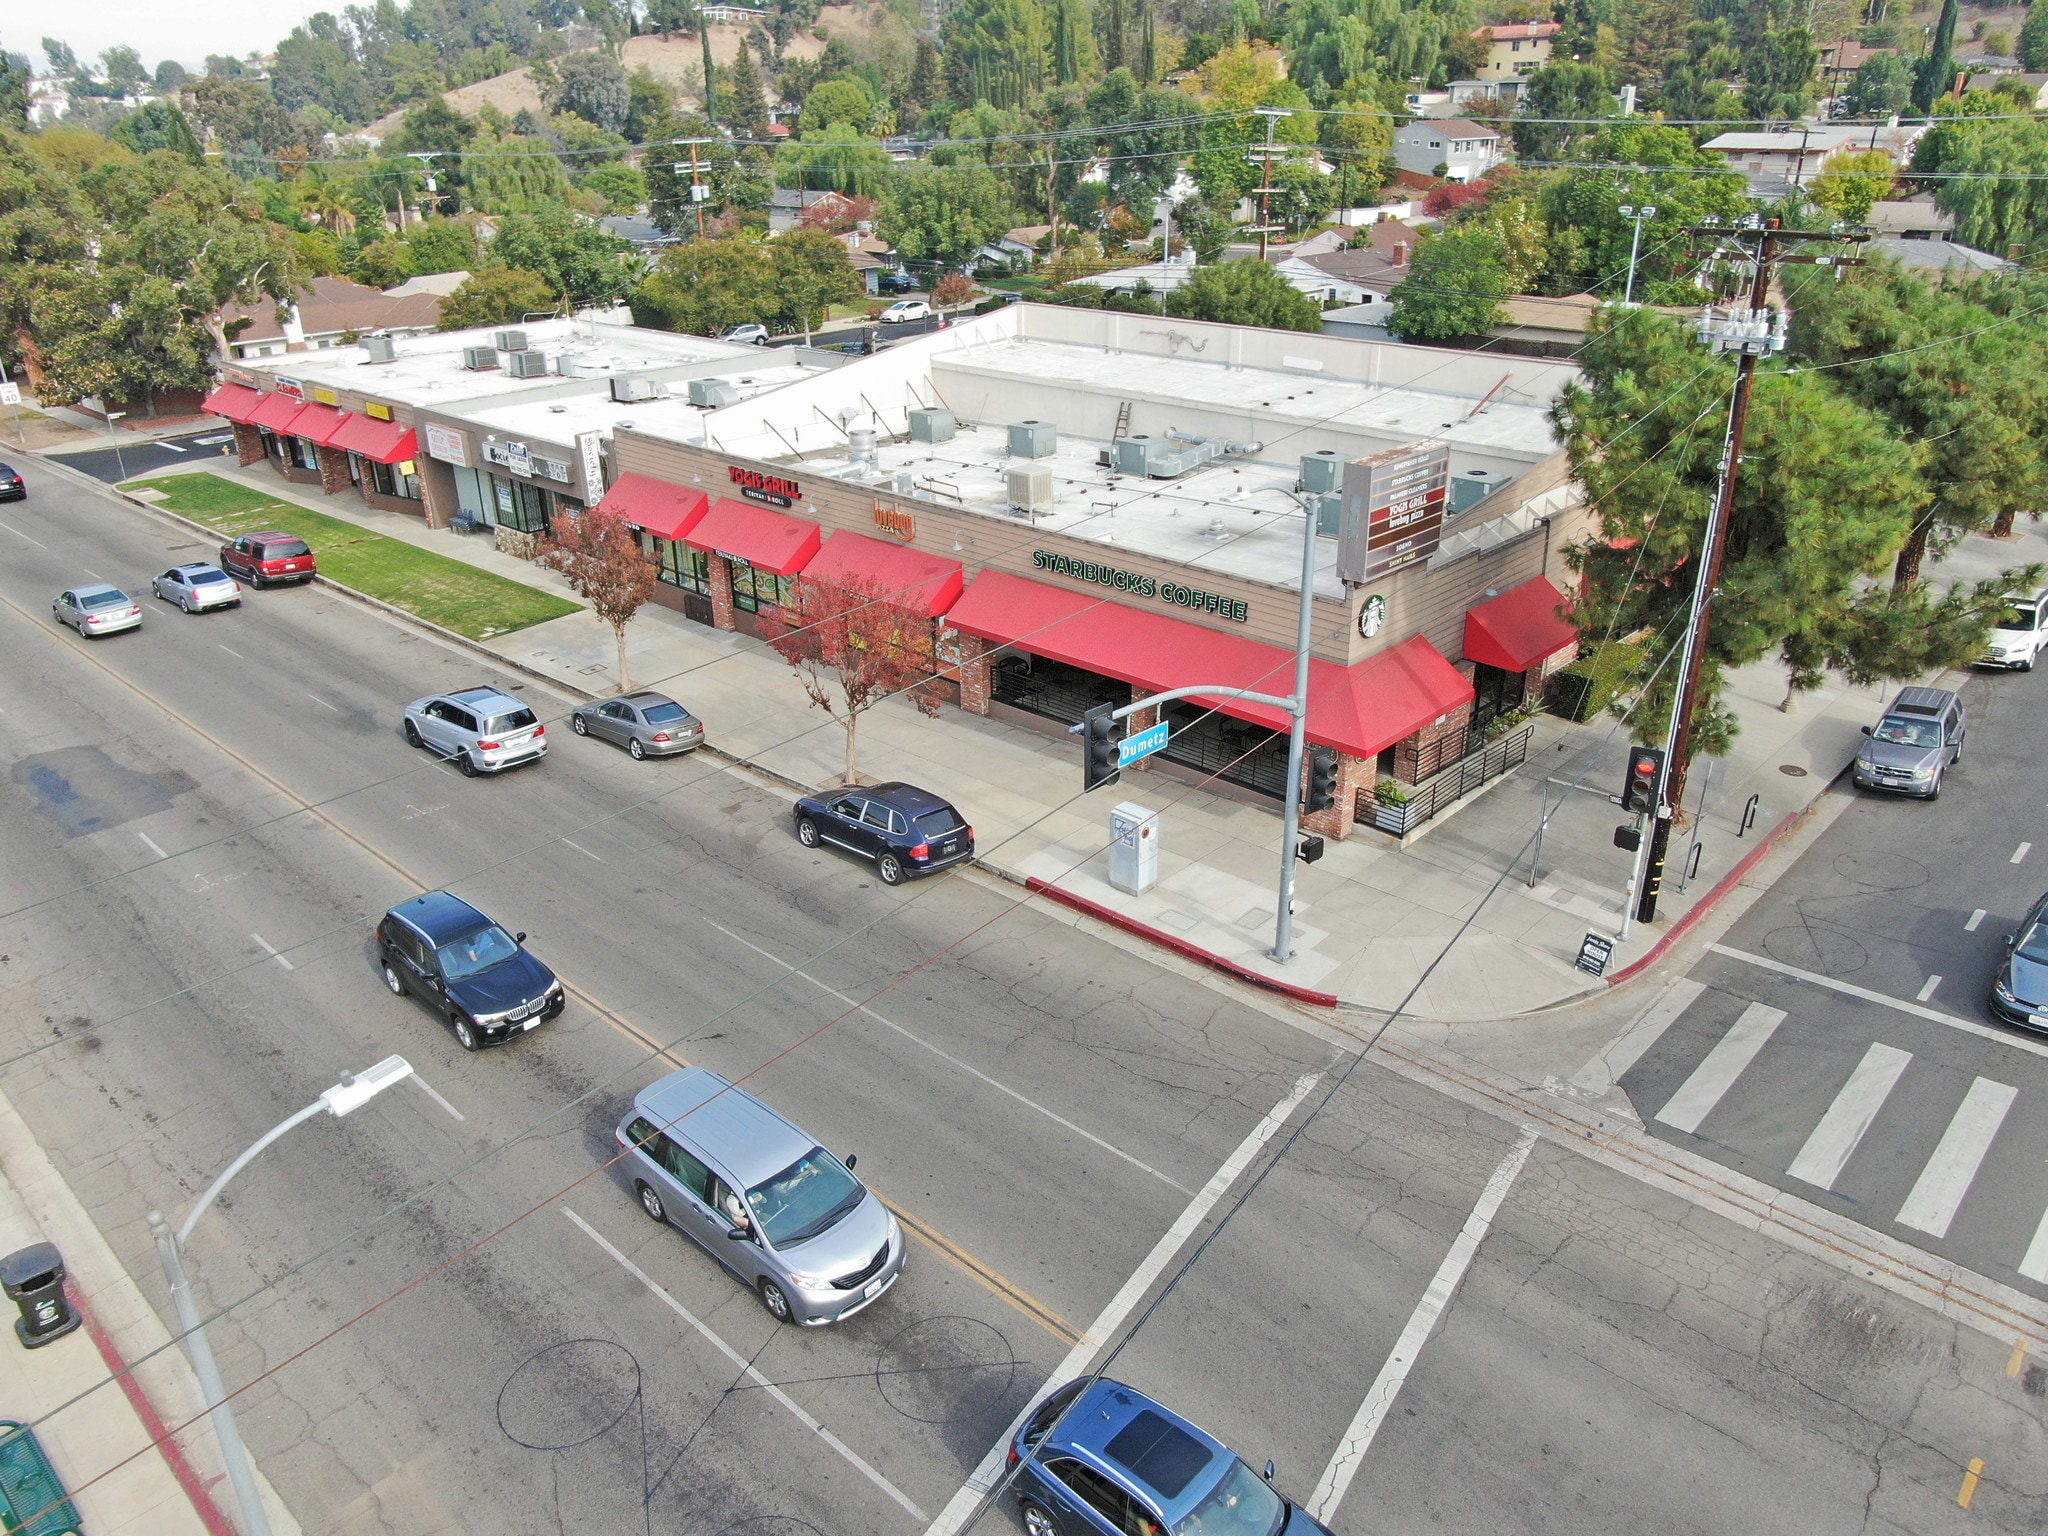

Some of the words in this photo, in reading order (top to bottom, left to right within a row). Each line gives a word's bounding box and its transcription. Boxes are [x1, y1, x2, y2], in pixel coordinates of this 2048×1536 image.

[5, 393, 18, 402] 40
[584, 437, 597, 477] Society
[728, 466, 764, 489] YOGIS
[764, 476, 802, 499] GRILL
[1391, 473, 1414, 487] STARBUCKS
[1414, 468, 1430, 479] COFFEE
[1408, 482, 1428, 495] CLEANERS
[772, 496, 785, 506] ROLL
[1409, 494, 1428, 510] GRILL
[1389, 511, 1410, 528] lovebug
[1410, 508, 1424, 523] pizza
[876, 524, 895, 535] PIZZA
[1389, 555, 1403, 568] SHINY
[1403, 551, 1416, 563] NAILS
[1031, 549, 1156, 597] STARBUCKS
[1160, 582, 1249, 622] COFFEE
[1122, 732, 1165, 760] Dumetz
[1587, 950, 1603, 960] HOUSE
[1591, 946, 1604, 955] OPEN
